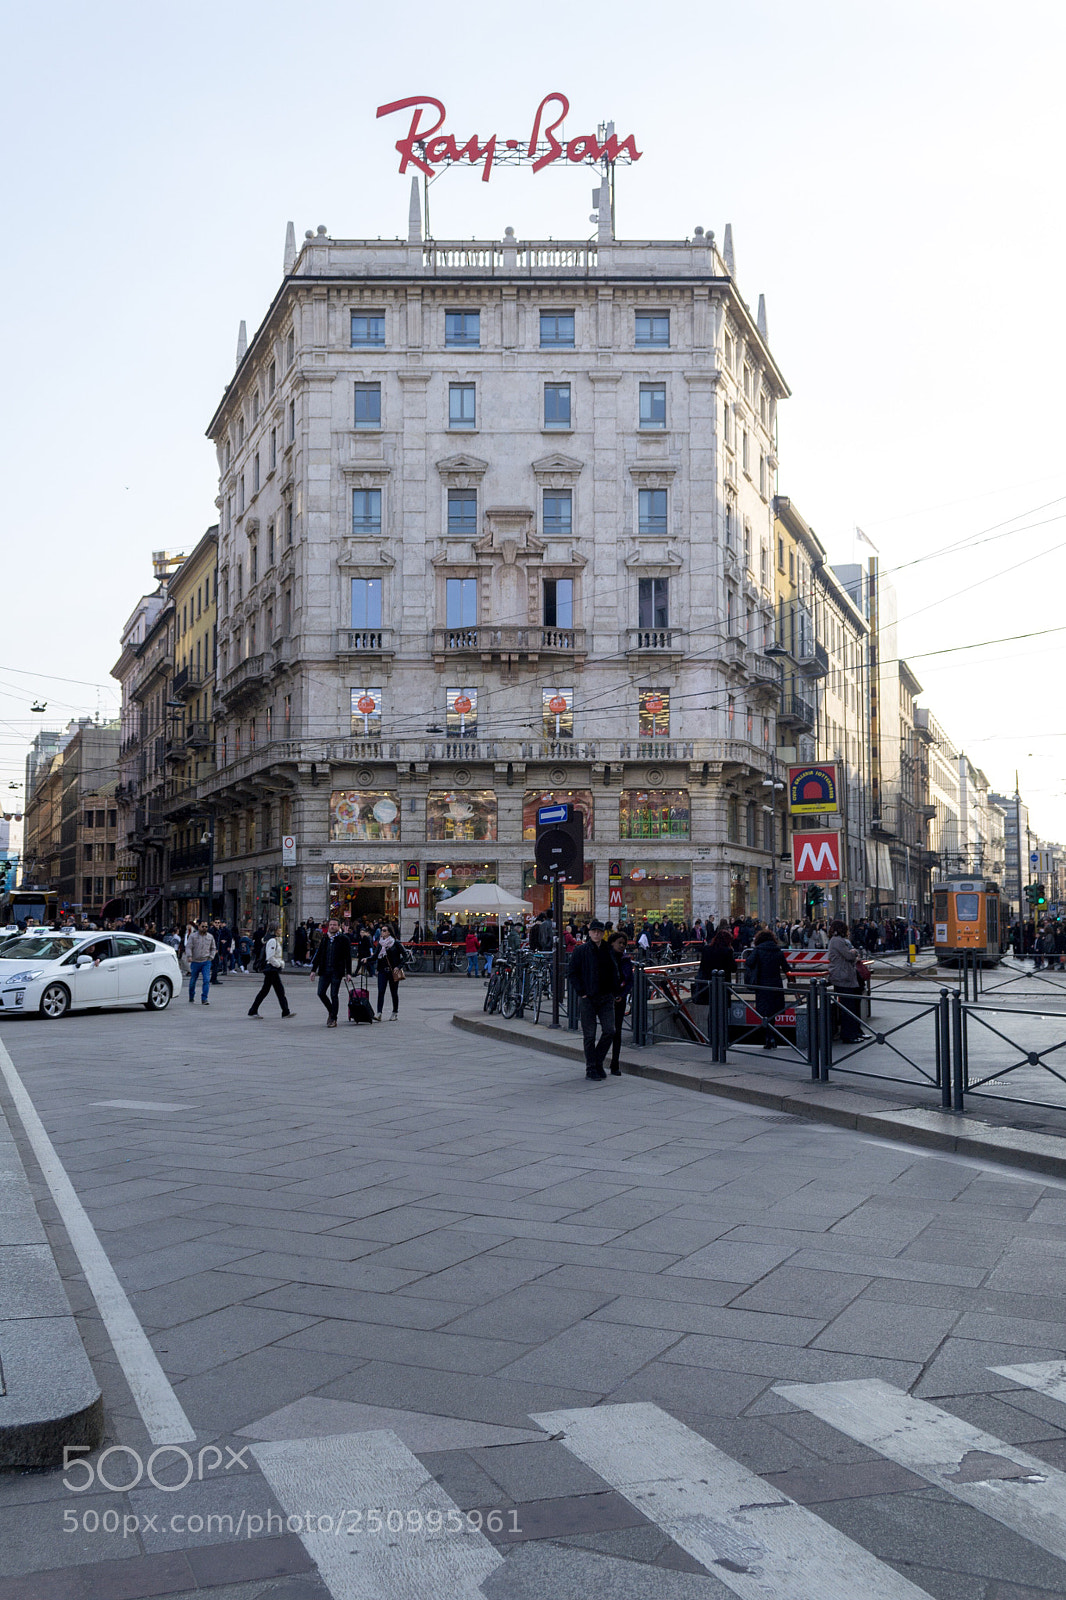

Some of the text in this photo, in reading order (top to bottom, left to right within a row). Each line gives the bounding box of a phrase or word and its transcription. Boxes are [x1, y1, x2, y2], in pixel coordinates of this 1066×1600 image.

[376, 92, 643, 182] Ray-Ban
[797, 842, 838, 872] M
[407, 891, 419, 904] M
[610, 890, 622, 903] M
